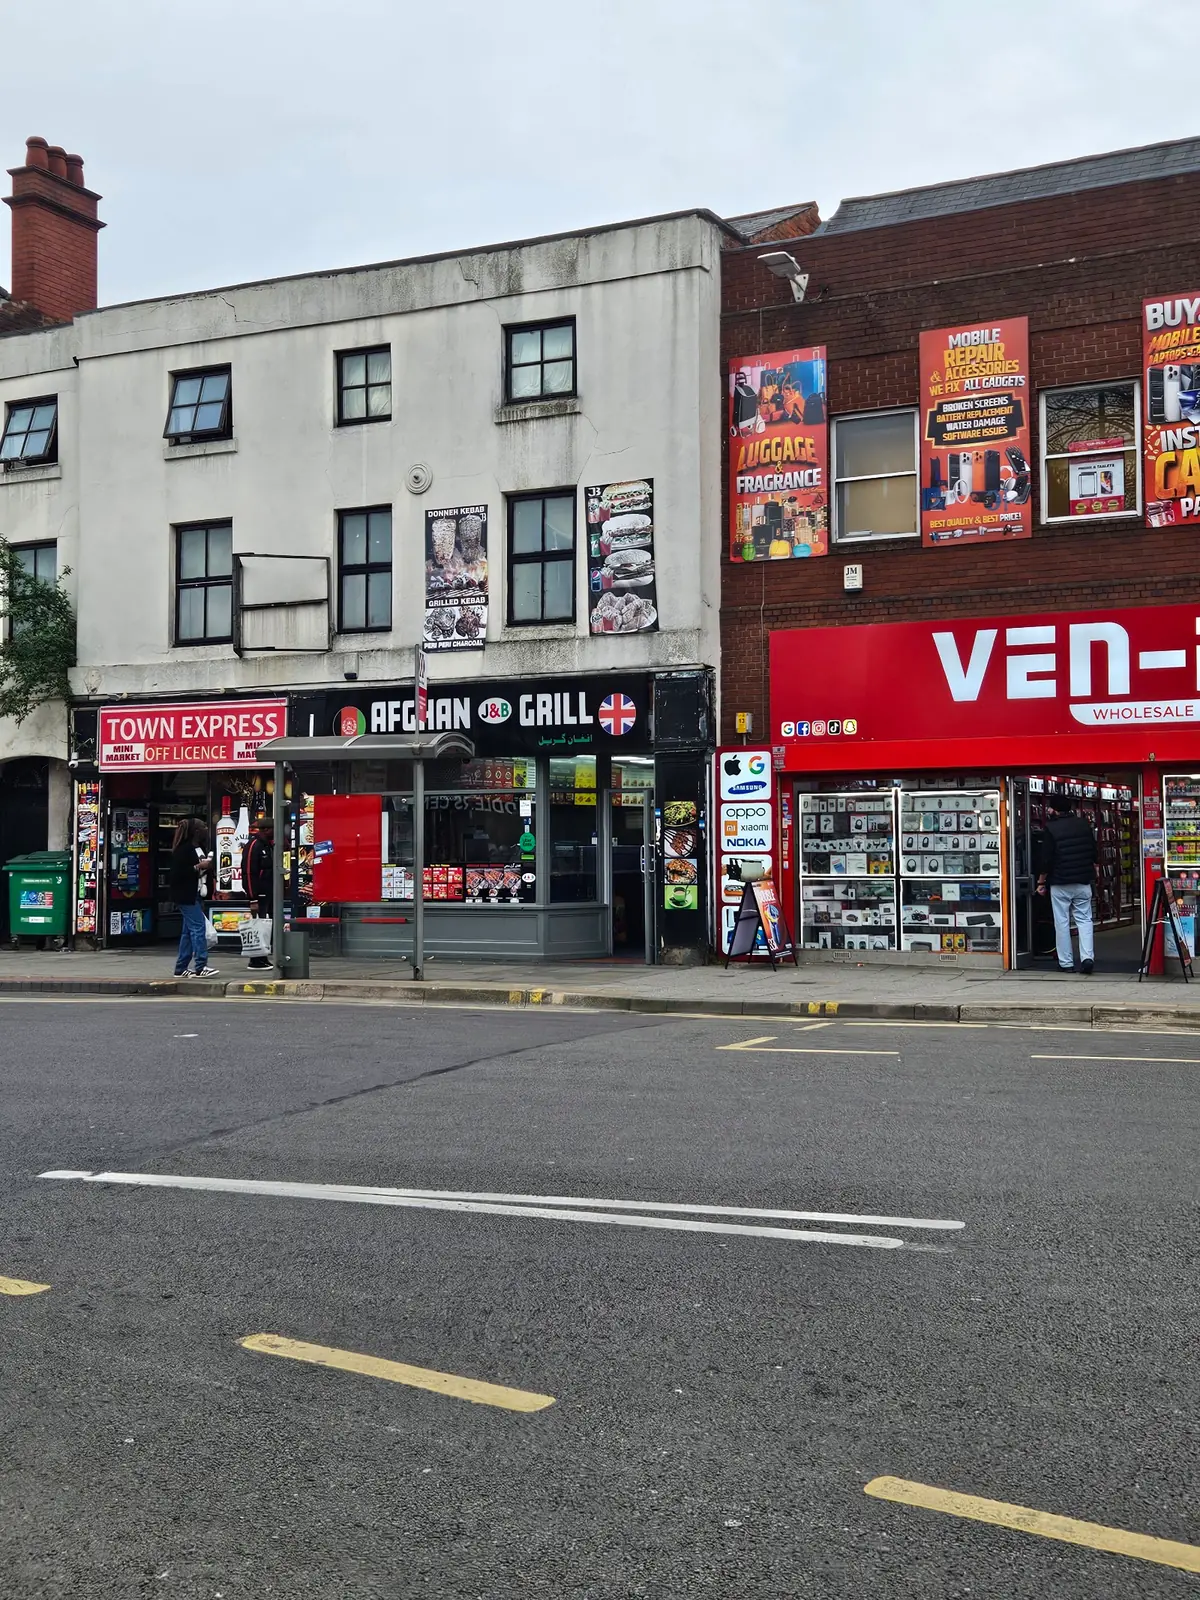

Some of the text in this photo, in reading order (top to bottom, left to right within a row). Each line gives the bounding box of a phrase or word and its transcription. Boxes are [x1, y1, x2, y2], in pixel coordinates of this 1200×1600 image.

[948, 328, 1001, 349] MOBILE
[943, 342, 1005, 368] REPAIR
[930, 359, 1020, 383] & ACCESSORIES
[928, 375, 1026, 396] WE FIX ALL GADGETS
[942, 396, 1009, 413] BROKEN SCREENS
[936, 405, 1014, 423] BATTERY REPLACEMENT
[946, 416, 1006, 431] WATER DAMAGE
[942, 426, 1008, 441] SOFTWARE ISSUES
[1160, 426, 1200, 452] INS
[737, 436, 818, 472] LUGGAGE
[775, 461, 783, 473] &
[736, 468, 822, 493] FRAGRANCE
[427, 506, 485, 518] DONNER KEBAB
[929, 512, 1022, 528] BEST QUALITY & BEST PRICE!
[846, 567, 857, 575] JM
[428, 596, 486, 607] GRILLED KEBAB
[452, 639, 484, 648] CHARCOAL
[371, 697, 470, 732] AFGHAN
[481, 702, 509, 719] J&B
[519, 692, 594, 726] GRILL
[1093, 705, 1194, 720] WHOLESALE
[107, 713, 277, 741] TOWN EXPRESS
[105, 753, 140, 762] MARKET
[113, 745, 133, 754] MINI
[145, 745, 227, 761] OFF LICENCE
[727, 838, 766, 846] NOKIA
